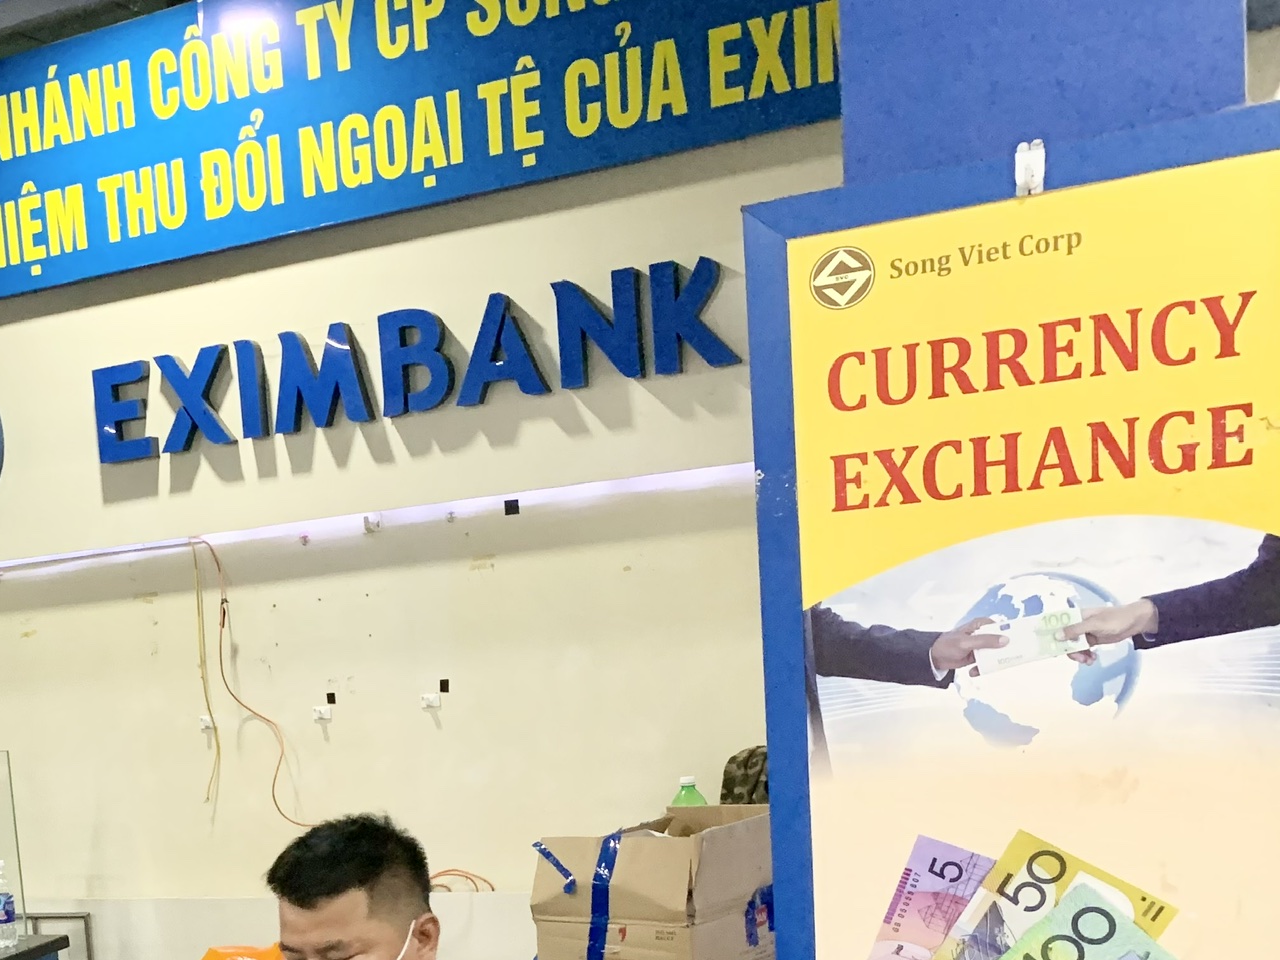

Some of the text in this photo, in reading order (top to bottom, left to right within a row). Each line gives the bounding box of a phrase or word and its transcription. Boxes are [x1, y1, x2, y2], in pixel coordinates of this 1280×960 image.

[148, 20, 283, 121] CÔNG
[295, 0, 354, 80] TY
[375, 0, 445, 60] CP
[97, 160, 187, 242] THU
[199, 111, 283, 221] ĐỔI
[299, 91, 463, 197] NGOẠI
[477, 57, 544, 167] TỆ
[563, 22, 688, 139] CỦA
[889, 228, 1083, 280] Song Viet Corp
[91, 256, 742, 465] EXIMBANK
[827, 290, 1257, 412] CURRENCY
[830, 403, 1255, 513] EXCHANGE
[1041, 612, 1070, 628] 100
[928, 857, 964, 883] 5
[997, 850, 1067, 912] 50
